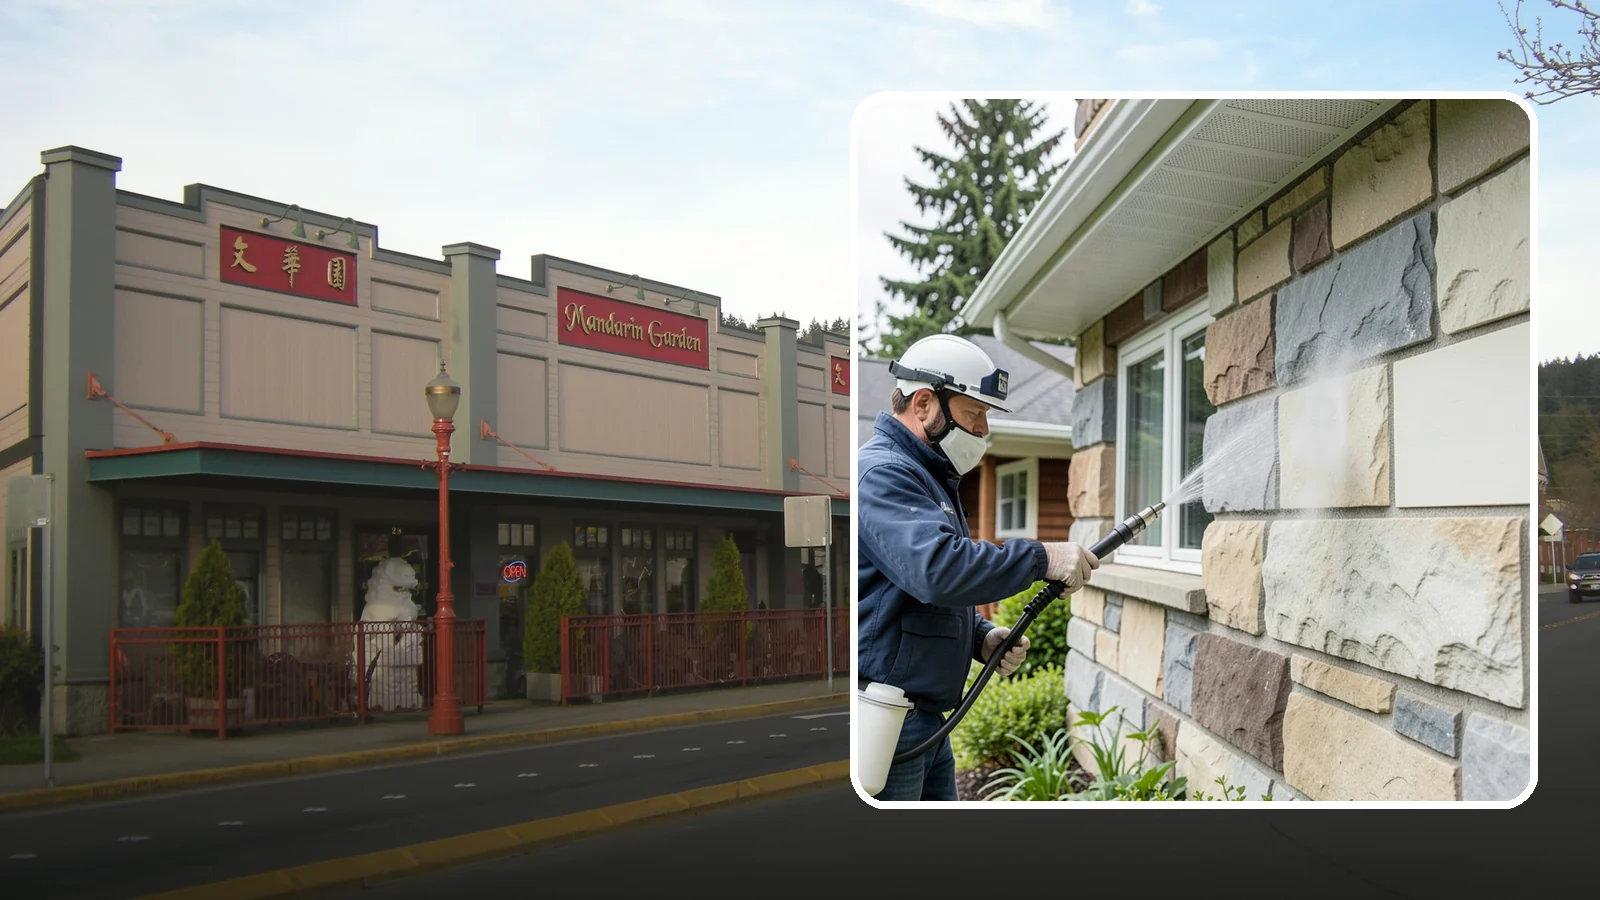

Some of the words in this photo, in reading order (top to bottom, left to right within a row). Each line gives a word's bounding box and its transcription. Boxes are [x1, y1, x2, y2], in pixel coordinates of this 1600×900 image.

[230, 235, 346, 290] 文華園
[564, 302, 644, 340] Mandarin
[647, 319, 702, 352] Garden
[503, 565, 527, 578] OPEN
